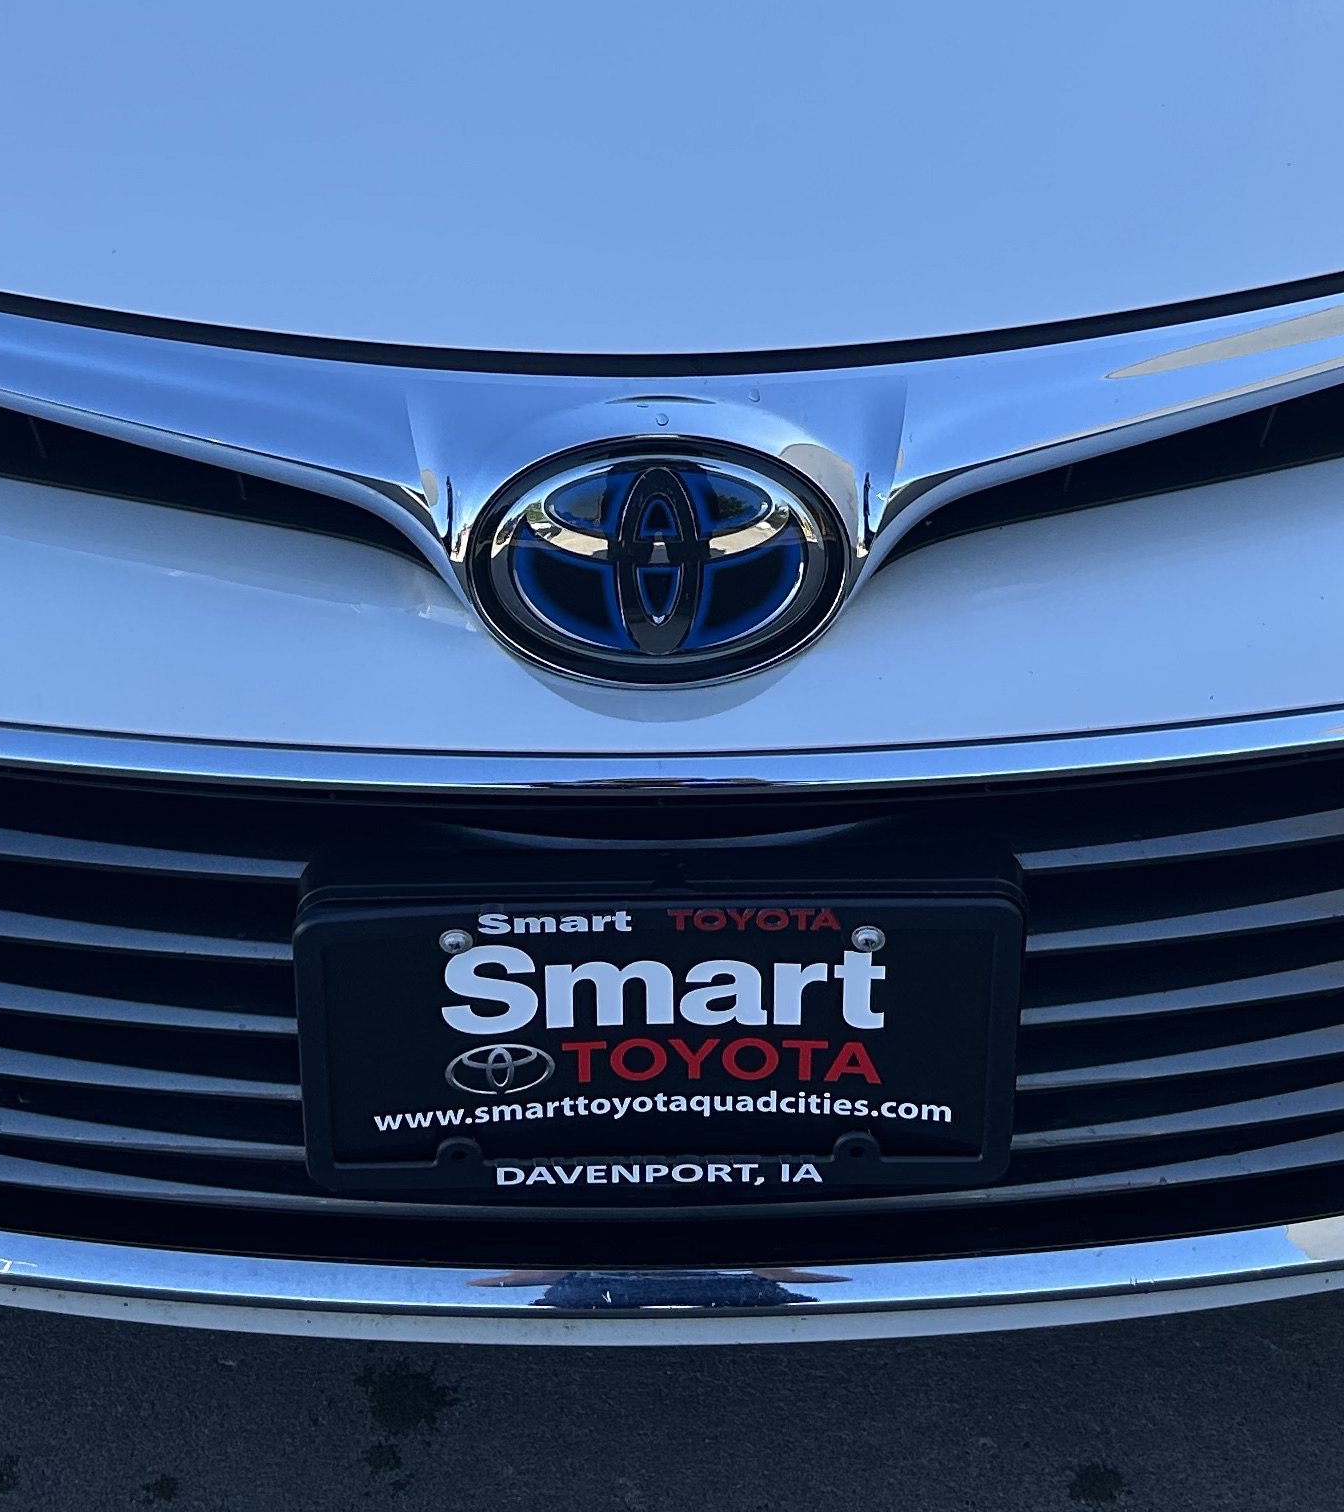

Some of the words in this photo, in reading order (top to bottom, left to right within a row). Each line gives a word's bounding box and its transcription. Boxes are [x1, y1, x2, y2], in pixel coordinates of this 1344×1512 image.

[477, 909, 632, 935] Smart
[667, 907, 842, 932] TOYOTA
[441, 944, 886, 1035] Smart
[562, 1037, 882, 1085] TOYOTA
[373, 1090, 953, 1132] www.smarttoyotaquadcities.com
[495, 1162, 766, 1187] DAVENPORT,
[781, 1162, 823, 1184] IA
